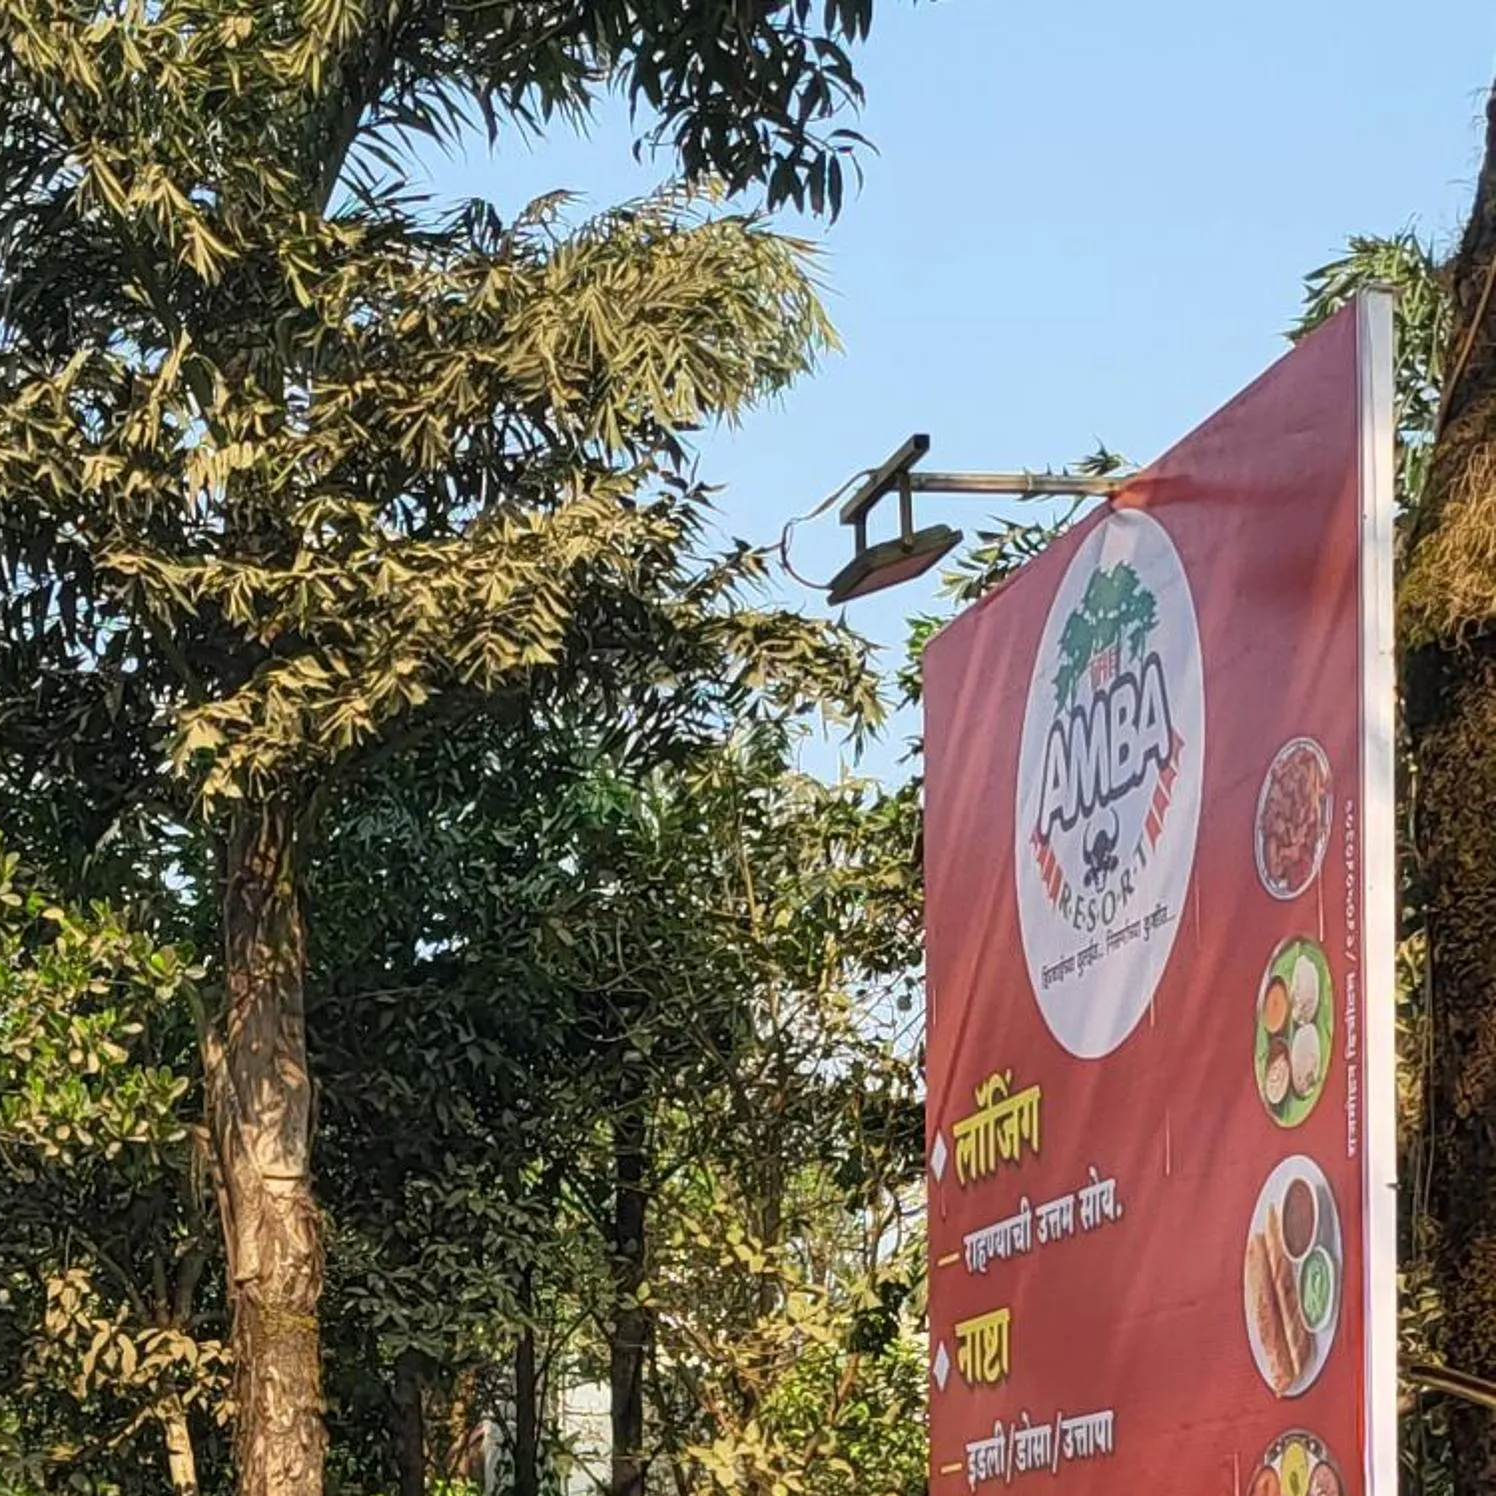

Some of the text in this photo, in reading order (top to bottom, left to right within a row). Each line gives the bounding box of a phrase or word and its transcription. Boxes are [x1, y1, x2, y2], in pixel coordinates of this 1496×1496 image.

[1036, 651, 1172, 845] AMBA
[953, 1065, 1042, 1185] लॉजिंग
[963, 1196, 1032, 1273] राहण्याची
[1035, 1194, 1075, 1244] उत्तम
[955, 1307, 1010, 1384] नाष्टा
